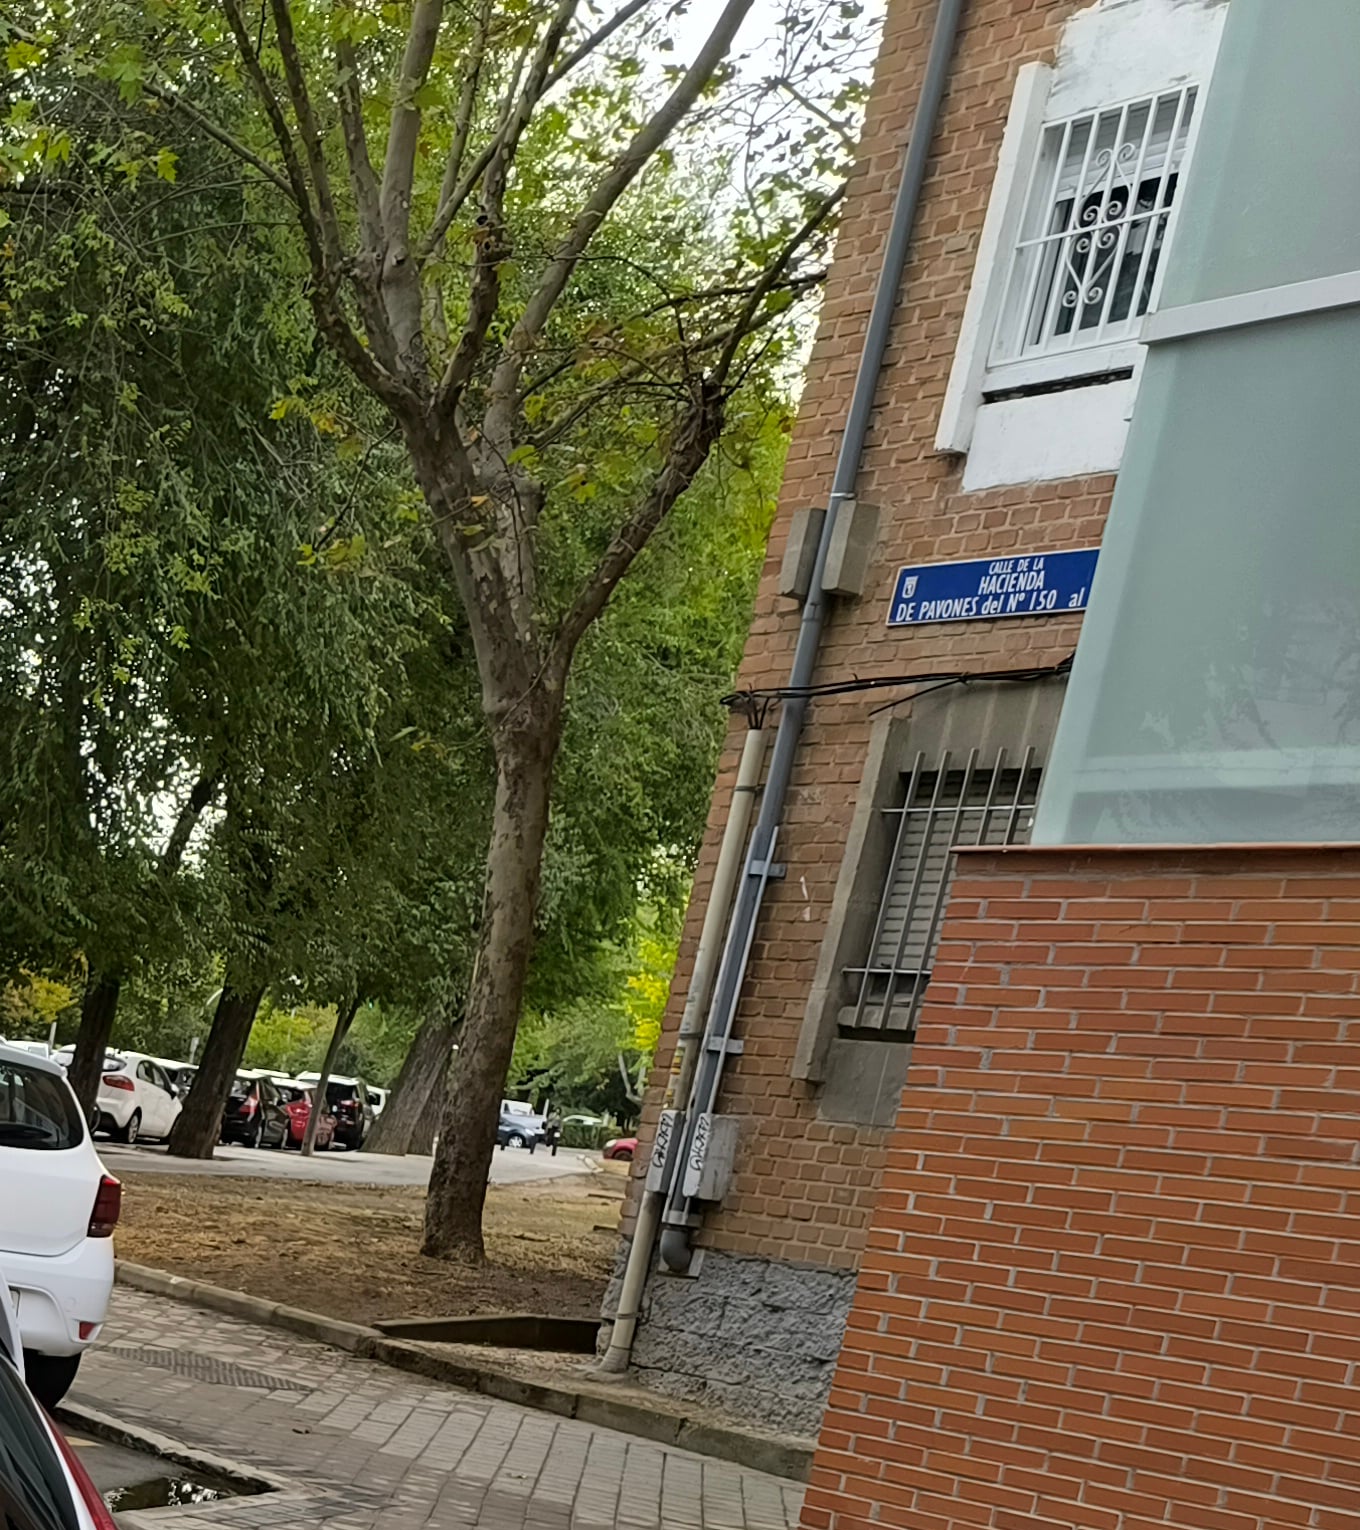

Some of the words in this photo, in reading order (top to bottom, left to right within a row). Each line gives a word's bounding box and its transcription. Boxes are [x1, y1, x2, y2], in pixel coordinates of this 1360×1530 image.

[988, 559, 1013, 575] CALLE
[1016, 558, 1030, 573] DE
[1032, 556, 1044, 571] LA
[977, 571, 1045, 596] HACIENDA
[895, 602, 914, 622] DE
[917, 597, 978, 620] PAVONES
[980, 595, 1003, 614] del
[1028, 589, 1058, 611] 150
[1068, 587, 1085, 608] al
